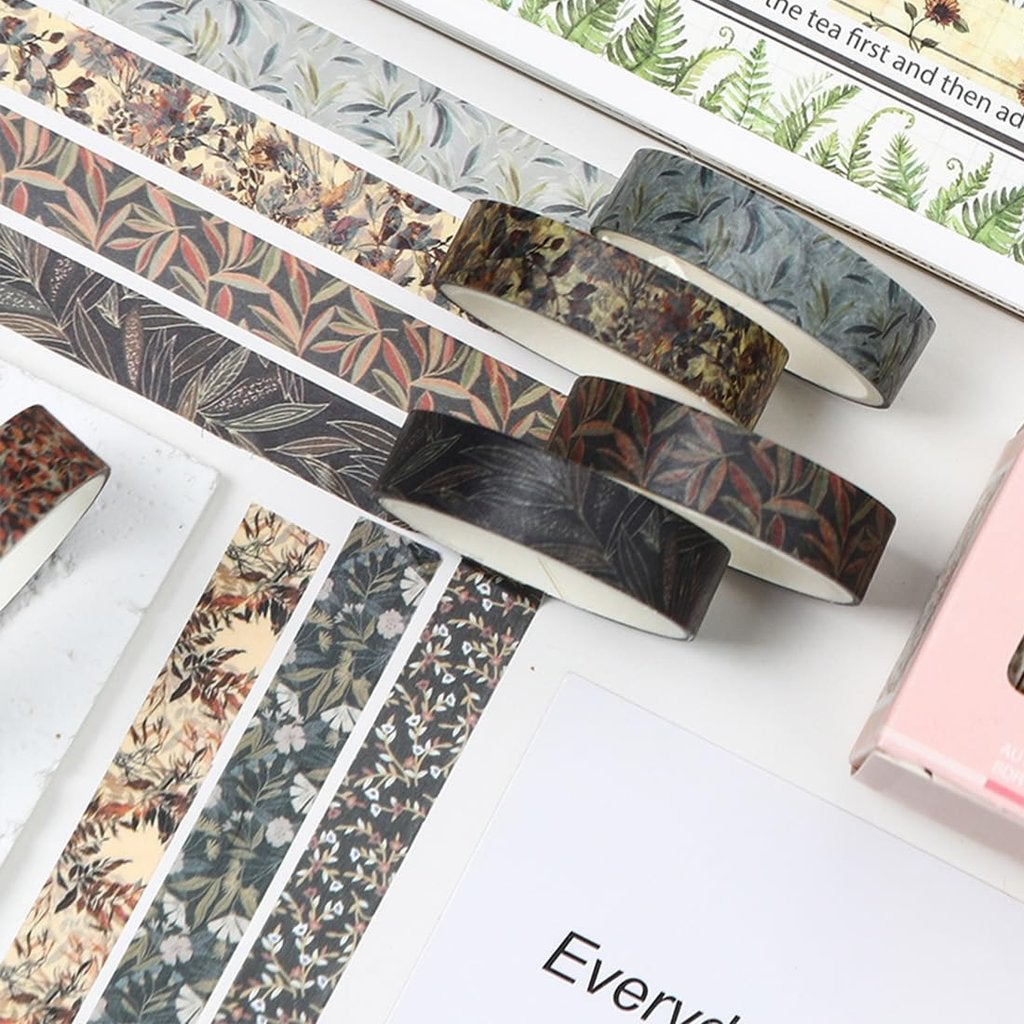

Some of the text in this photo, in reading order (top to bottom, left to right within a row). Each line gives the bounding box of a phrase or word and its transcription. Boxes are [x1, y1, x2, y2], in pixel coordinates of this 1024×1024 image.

[807, 9, 842, 40] tea
[845, 27, 890, 64] first
[892, 55, 939, 86] and
[940, 75, 991, 113] then
